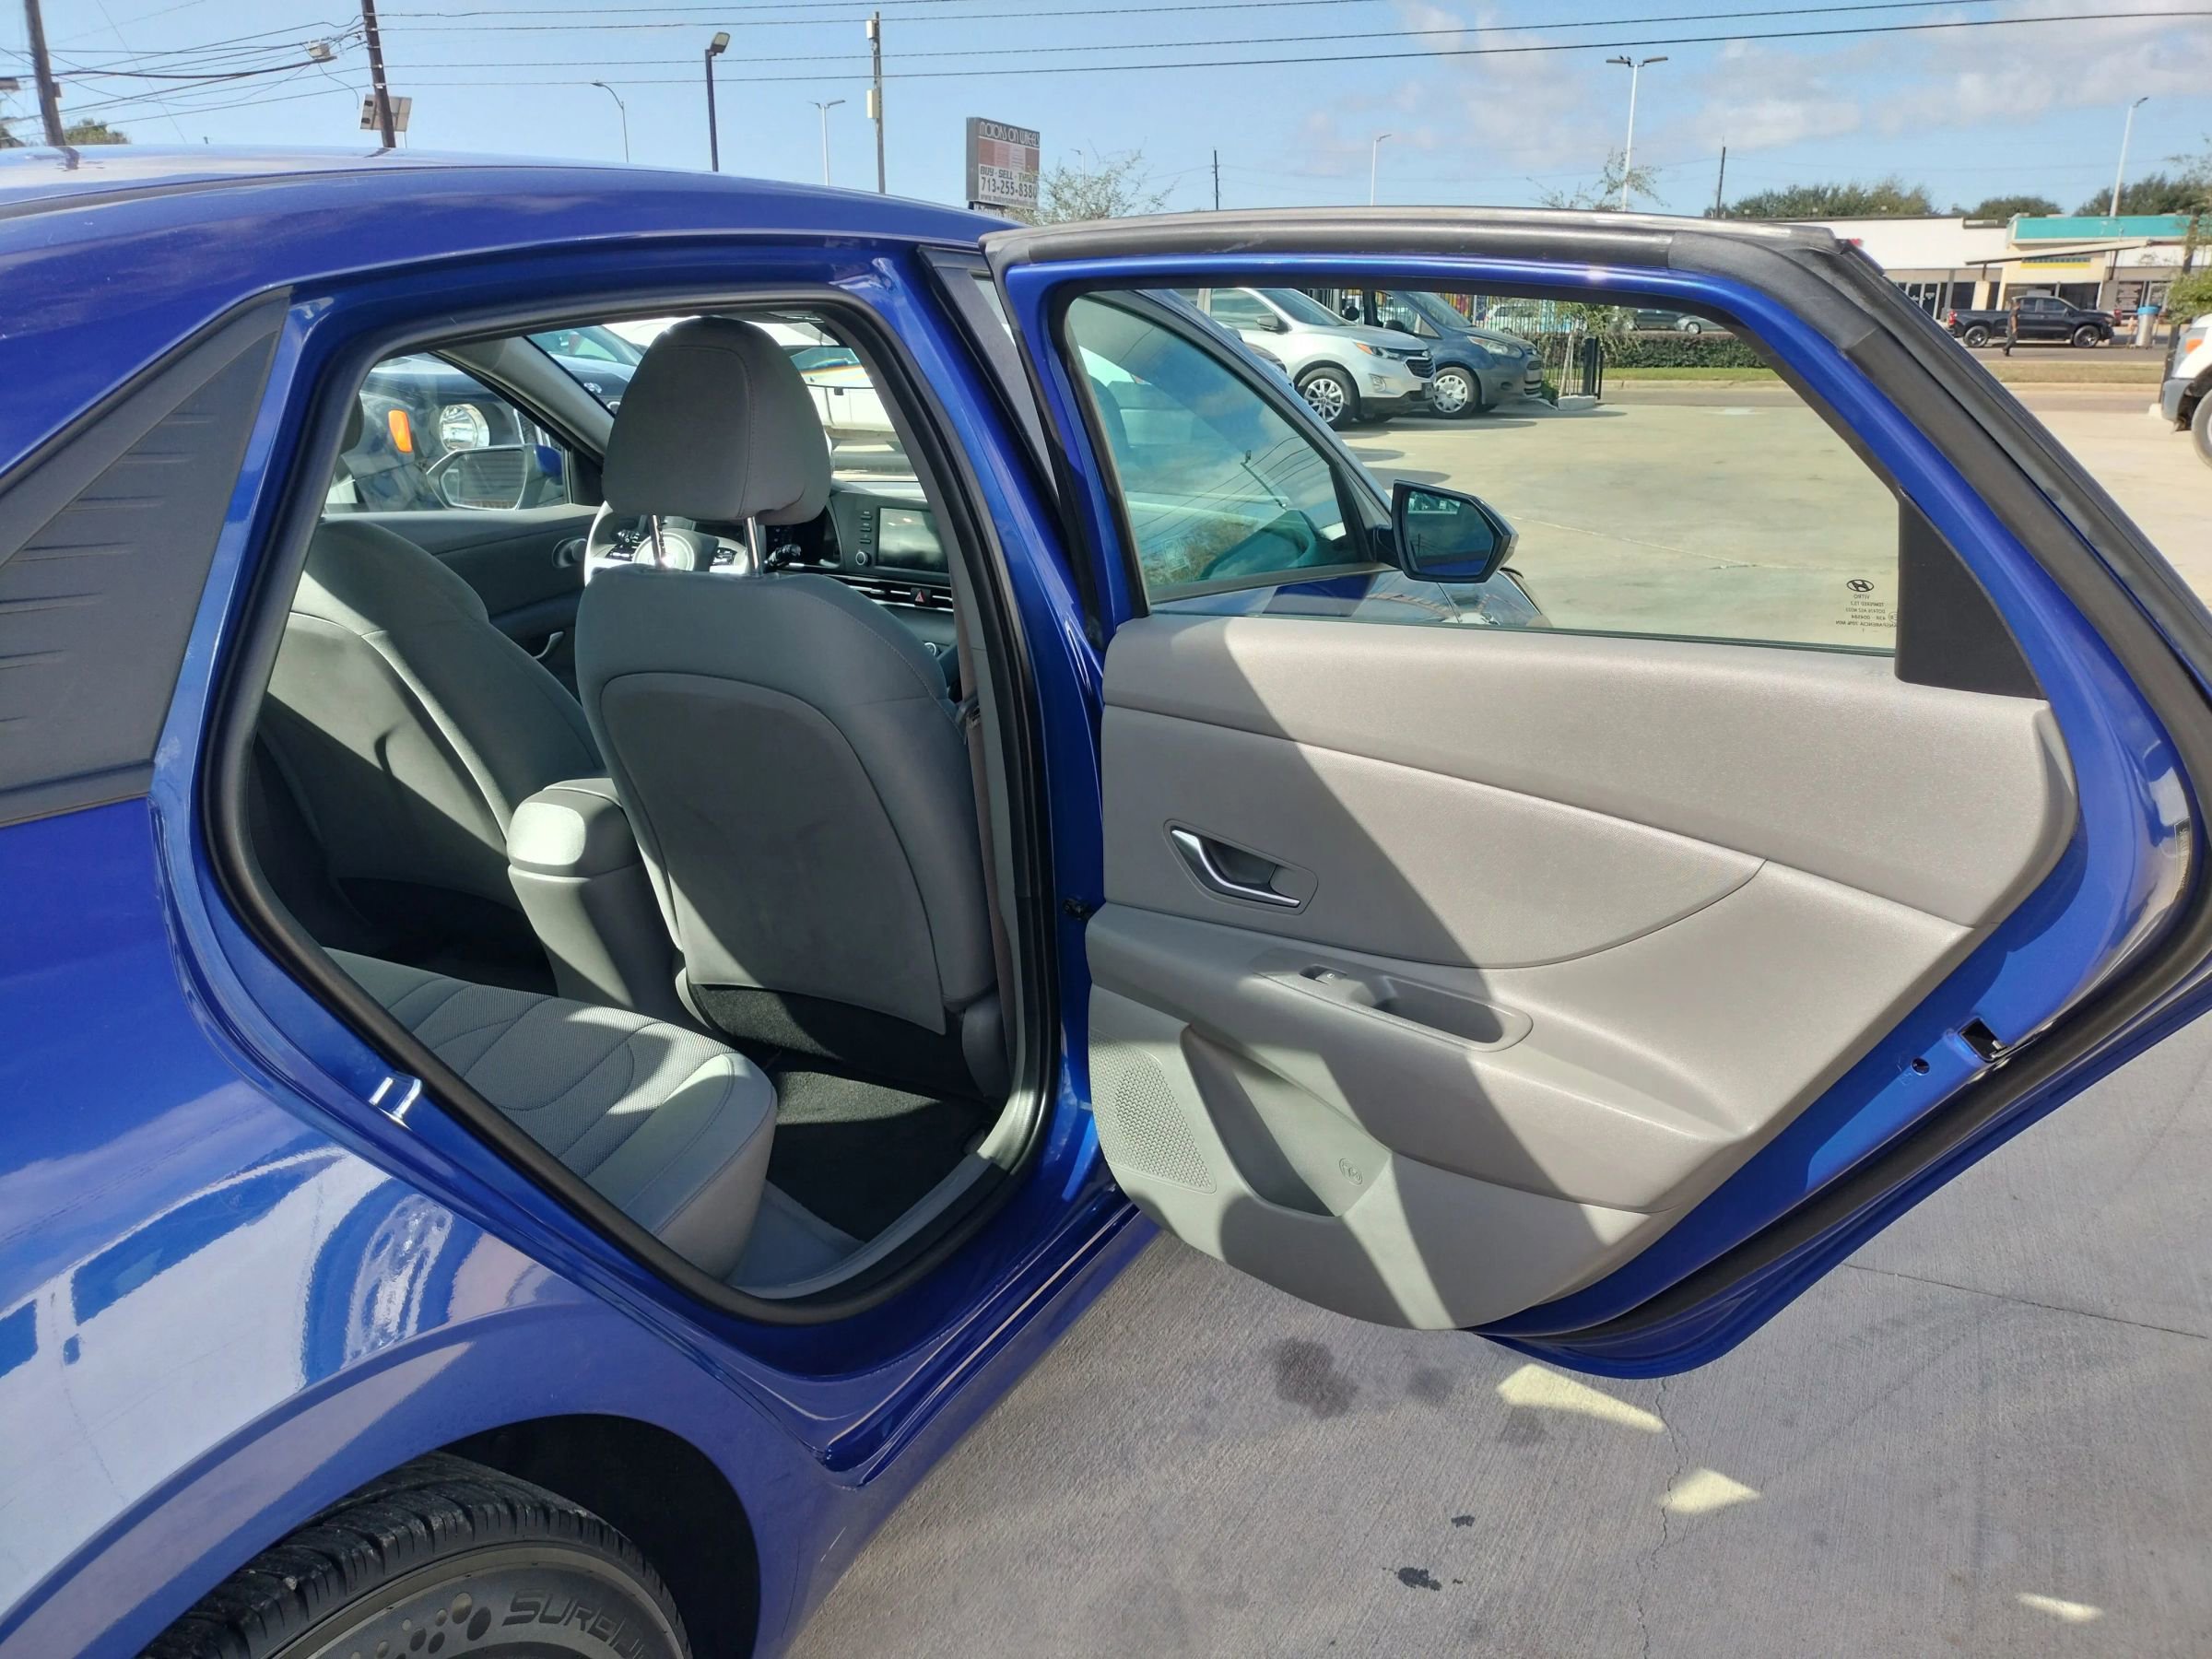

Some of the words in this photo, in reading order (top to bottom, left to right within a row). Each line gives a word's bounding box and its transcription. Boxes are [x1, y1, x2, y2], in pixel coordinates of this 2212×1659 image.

[980, 166, 994, 177] BUY
[998, 170, 1013, 181] SELL
[981, 177, 1038, 199] 713-255-8380
